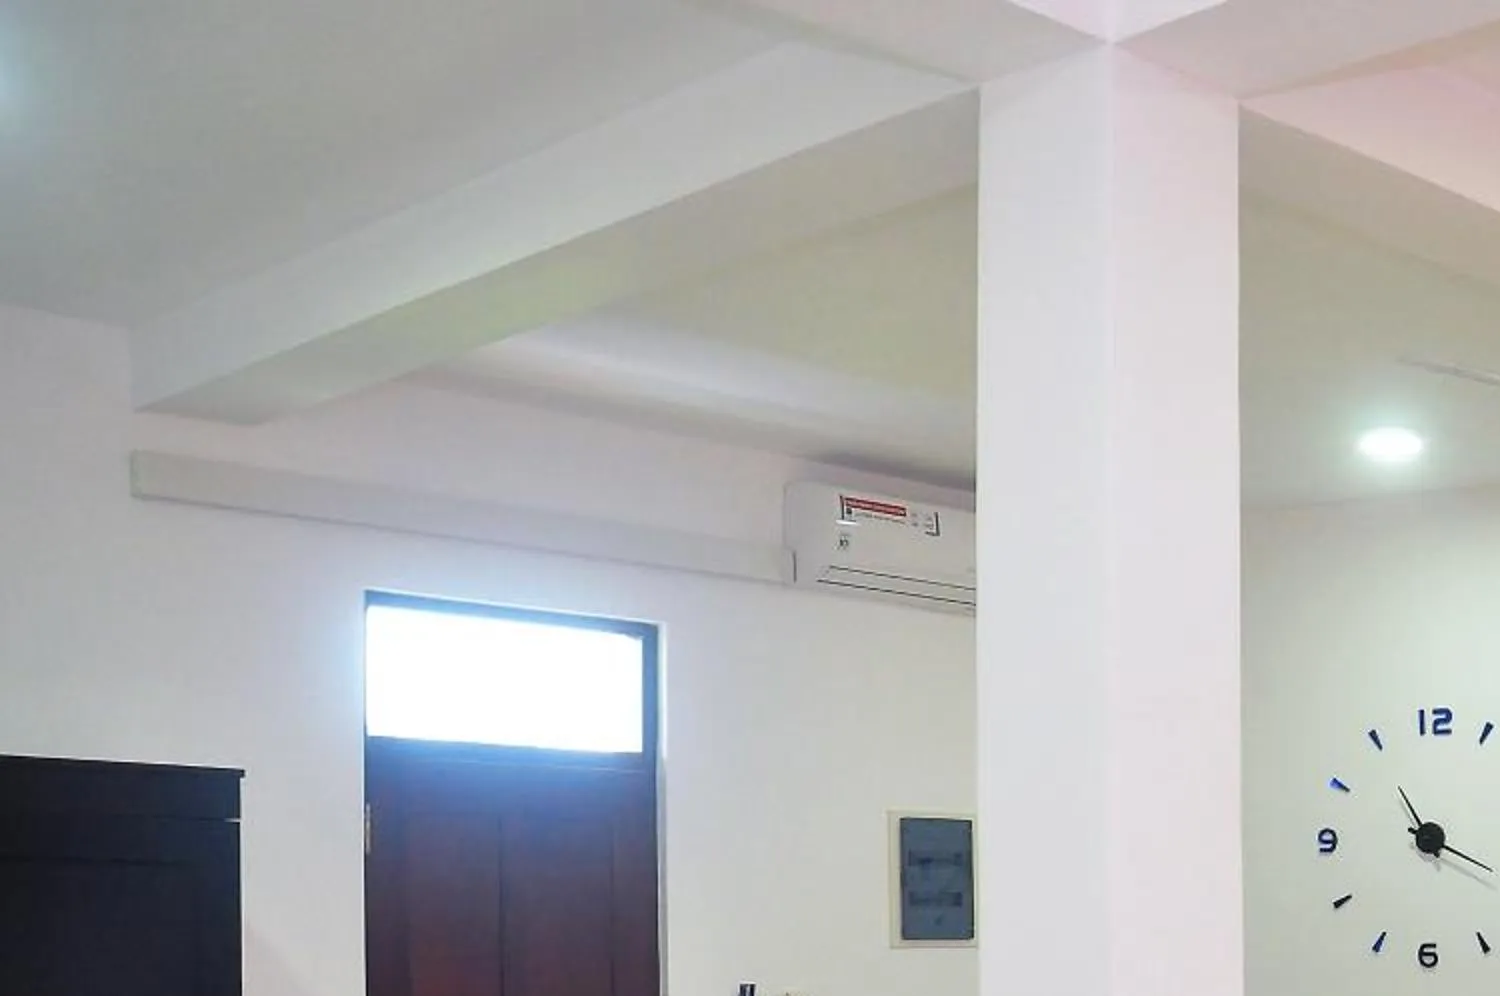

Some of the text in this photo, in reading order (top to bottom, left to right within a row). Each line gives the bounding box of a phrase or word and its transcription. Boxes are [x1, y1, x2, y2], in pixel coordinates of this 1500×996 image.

[1418, 708, 1452, 736] 12
[1318, 828, 1338, 854] 9
[1418, 943, 1438, 968] 6
